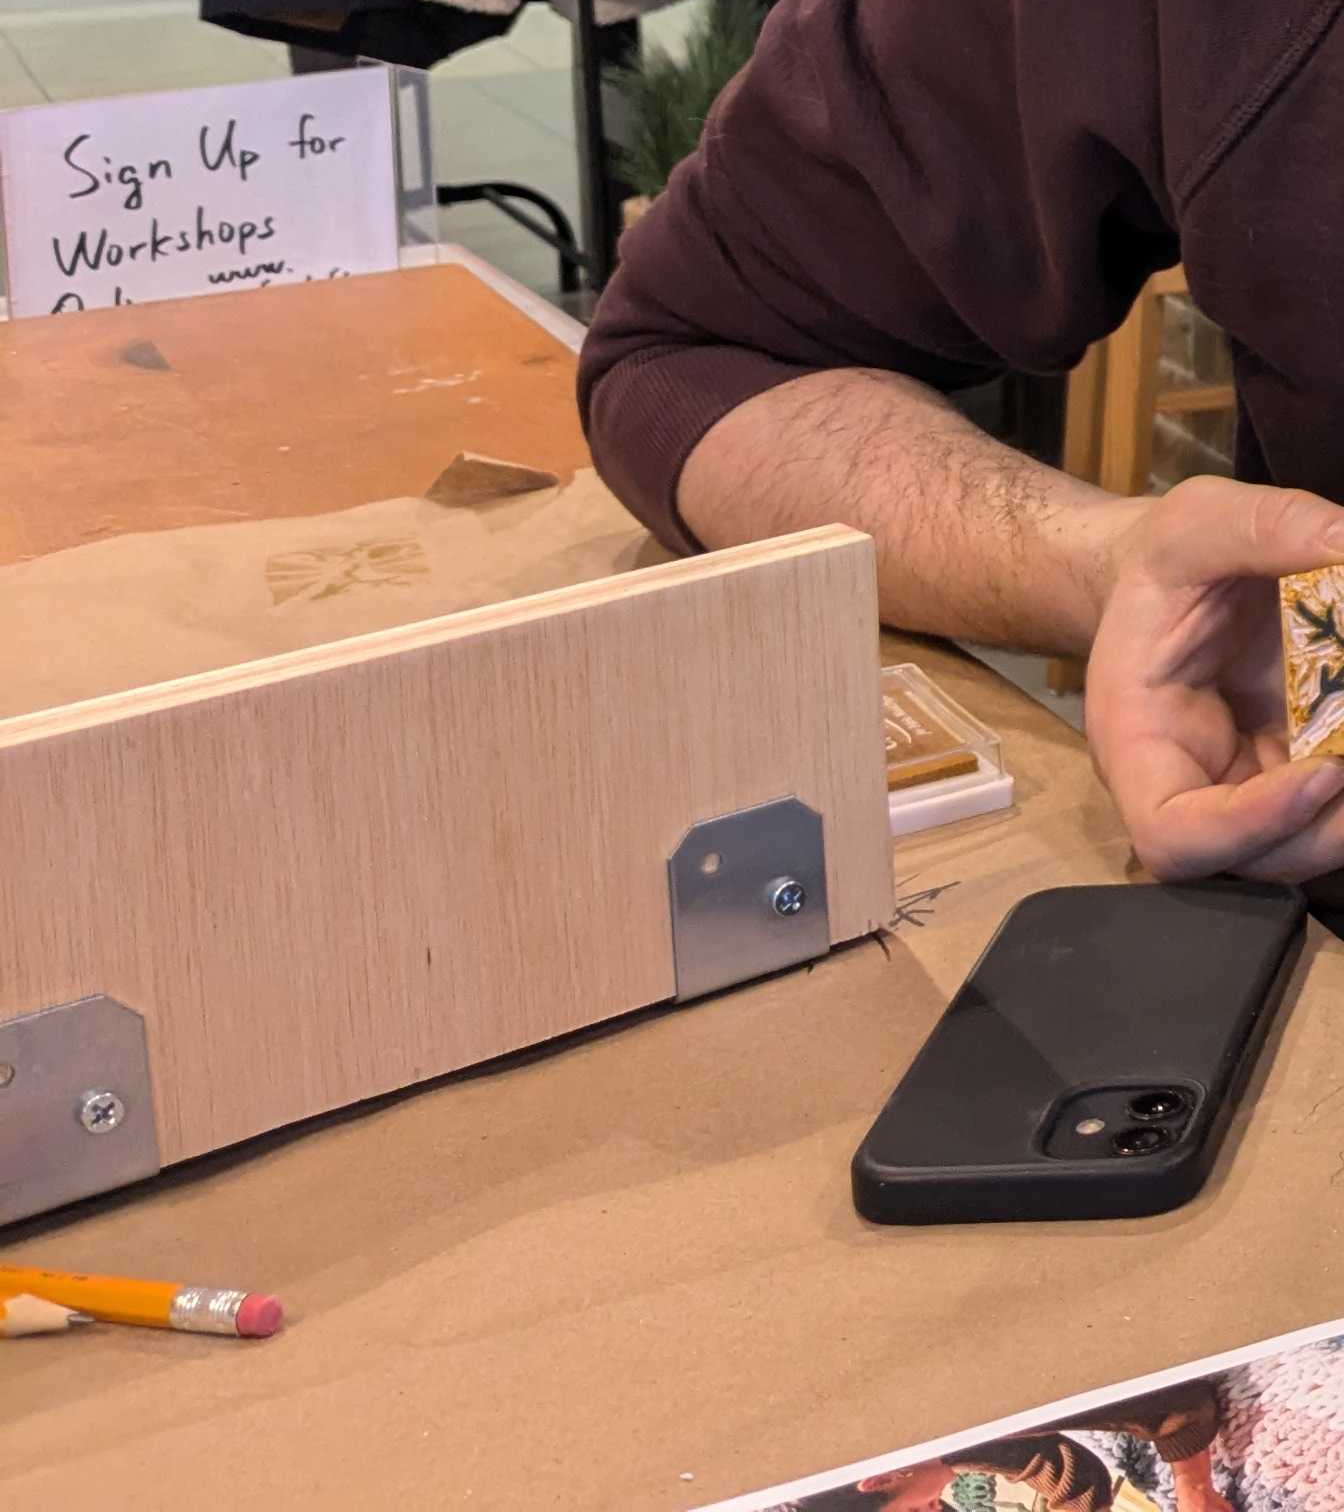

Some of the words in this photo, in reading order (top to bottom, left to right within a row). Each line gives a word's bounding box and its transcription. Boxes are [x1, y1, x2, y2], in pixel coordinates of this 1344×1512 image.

[65, 134, 173, 209] Sign
[199, 119, 260, 180] Up
[289, 113, 347, 160] for
[52, 206, 275, 276] Workshops
